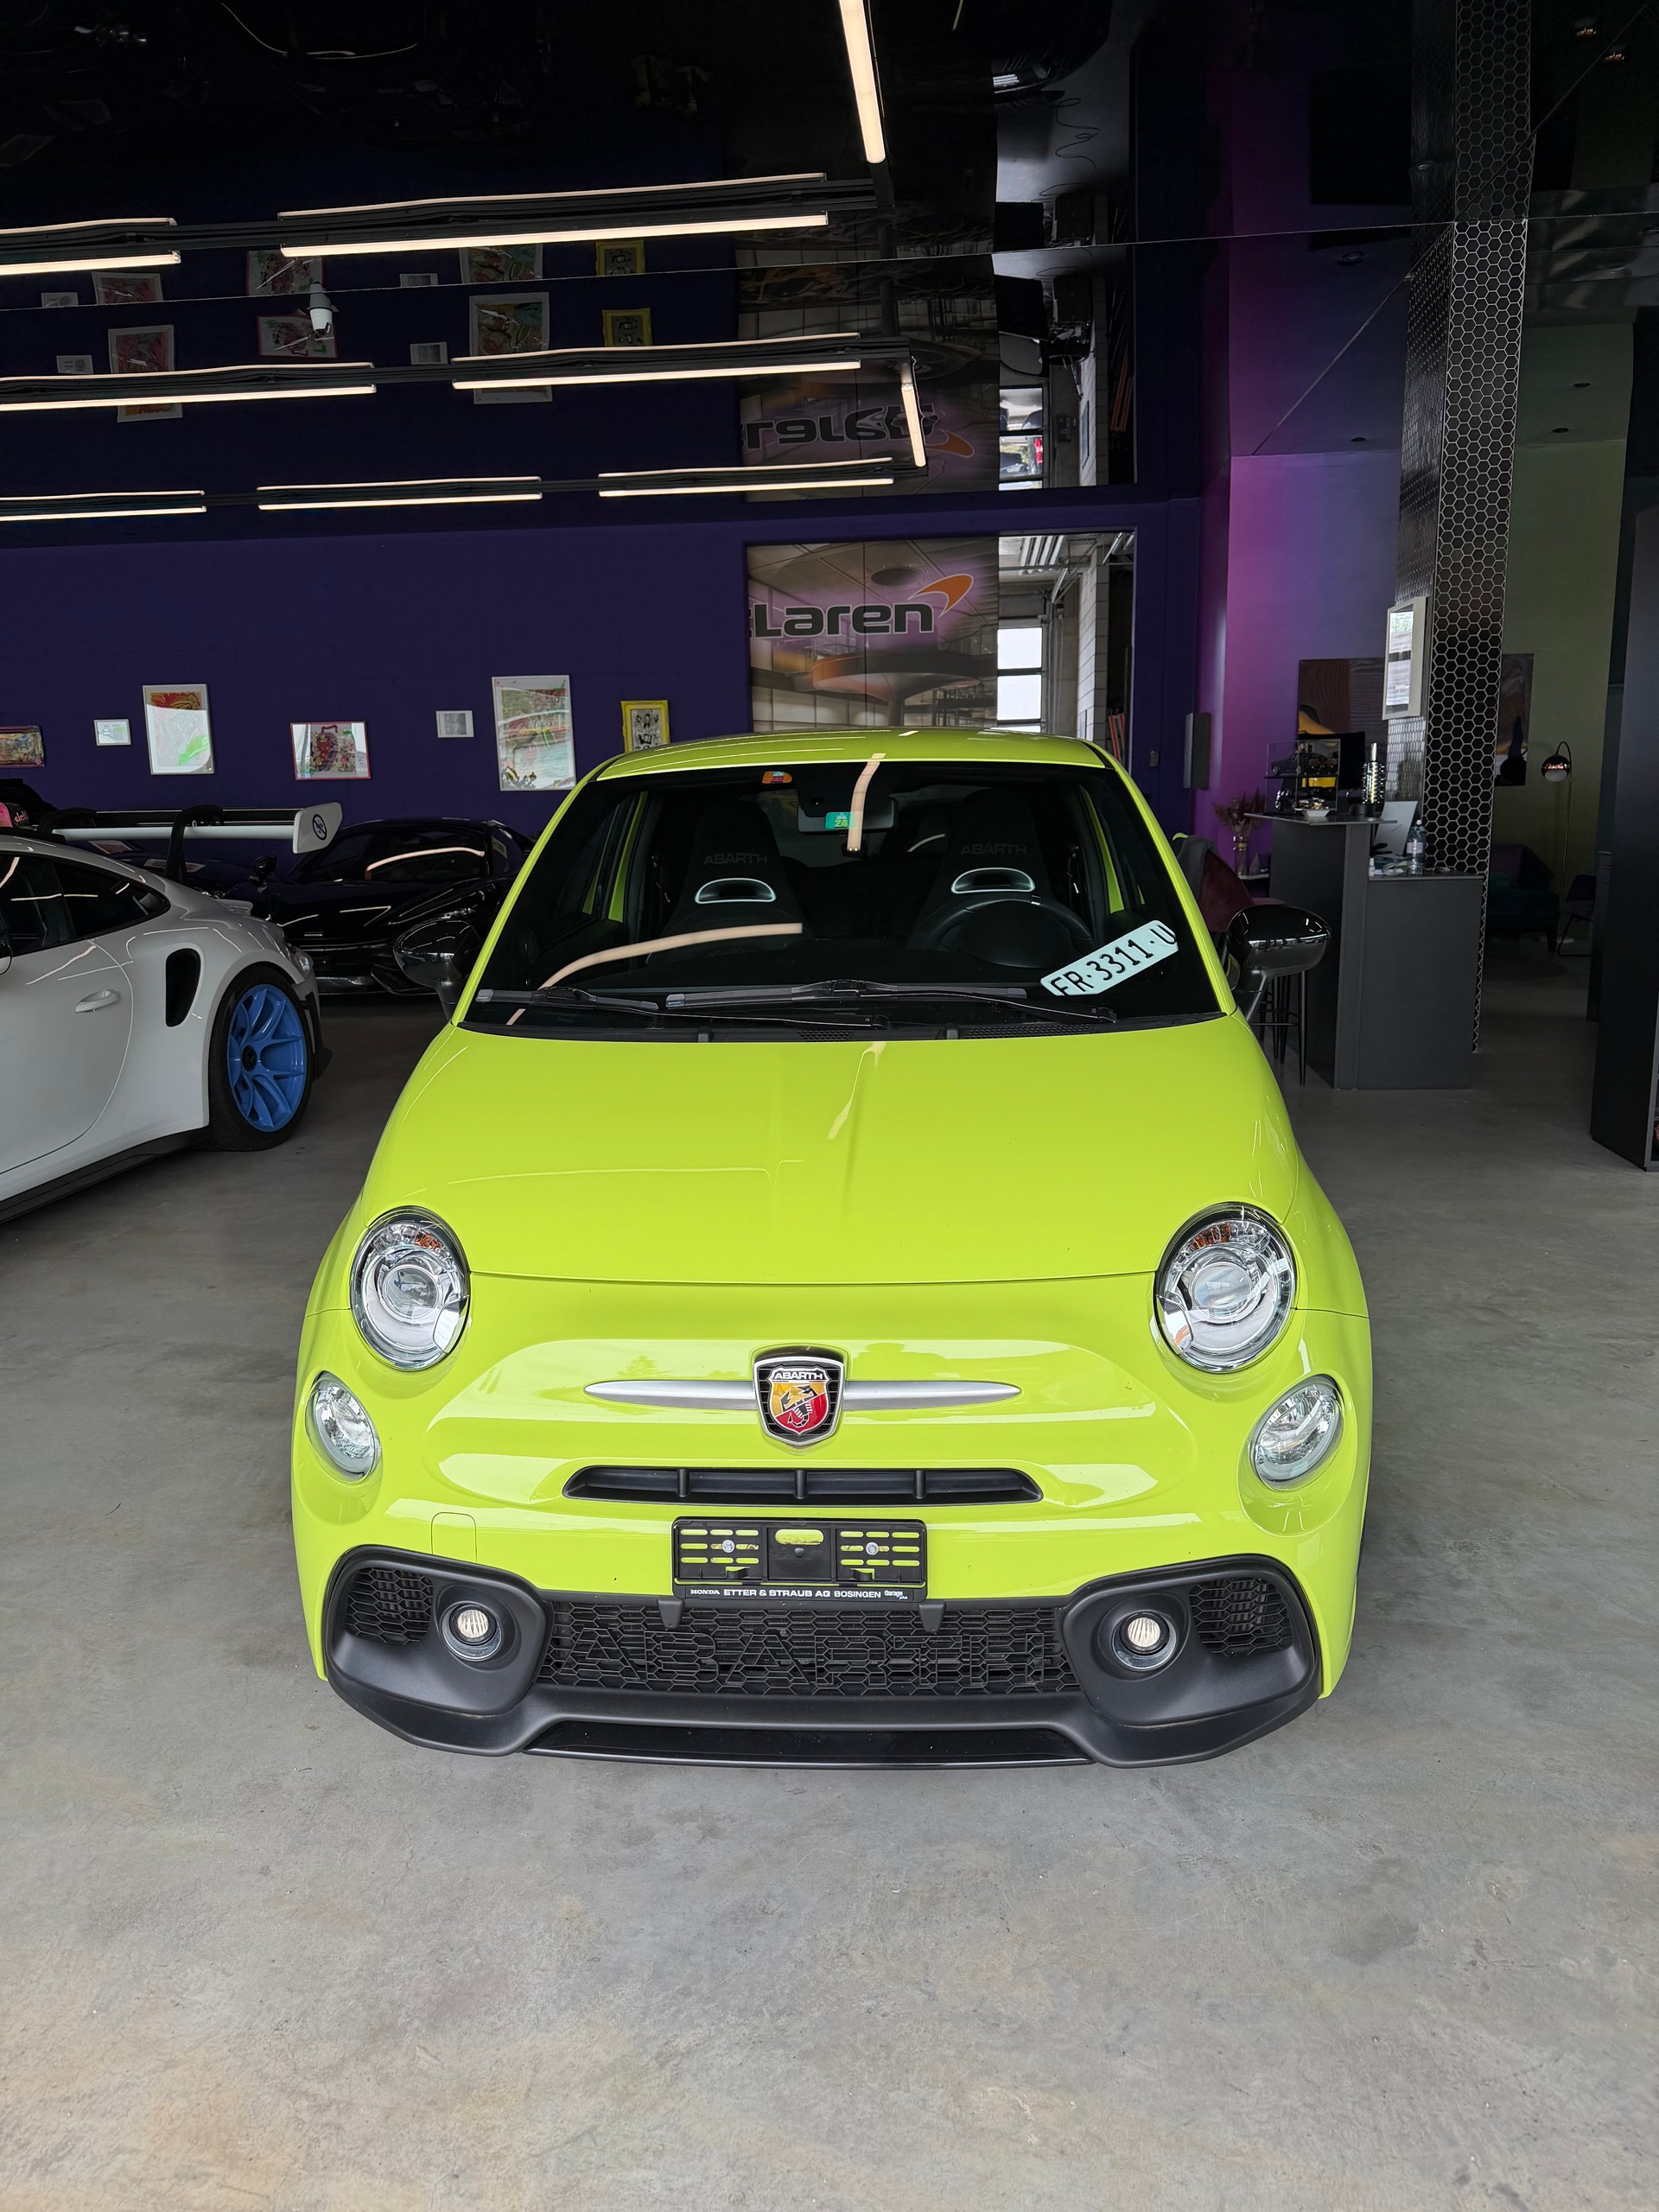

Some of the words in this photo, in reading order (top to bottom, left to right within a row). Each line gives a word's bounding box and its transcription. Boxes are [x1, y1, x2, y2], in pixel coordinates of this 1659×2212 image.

[748, 602, 934, 639] Laren
[834, 819, 849, 828] 24
[960, 842, 1027, 855] ABARTH
[703, 851, 767, 865] ABARTH
[774, 1371, 823, 1380] ABARTH
[556, 1626, 1045, 1685] ABARTH
